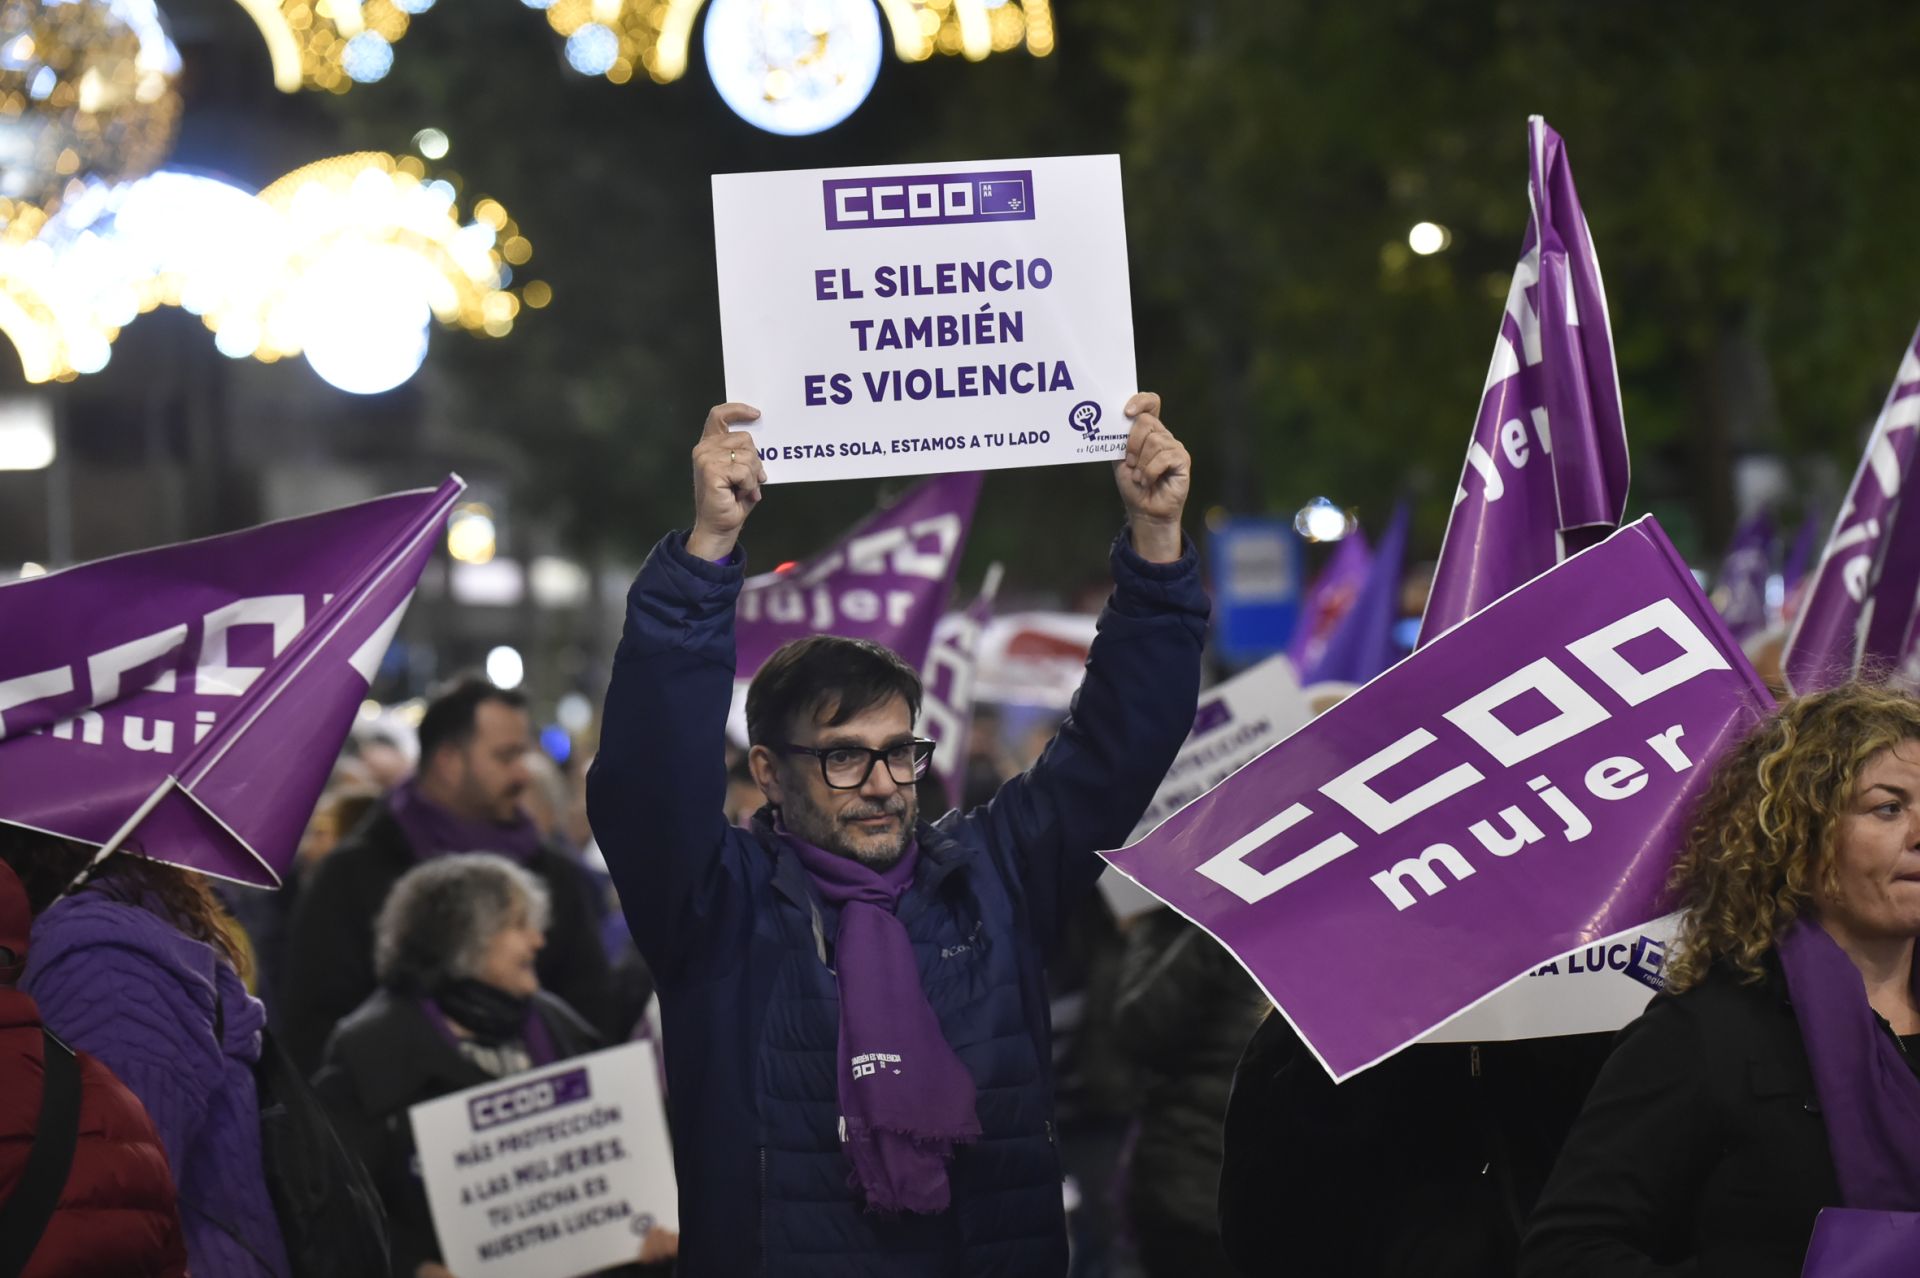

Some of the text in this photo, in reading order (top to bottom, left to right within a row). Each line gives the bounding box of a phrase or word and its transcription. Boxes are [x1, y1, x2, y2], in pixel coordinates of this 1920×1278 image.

[834, 182, 974, 223] CCOO
[815, 257, 1053, 301] EL SILENCIO
[850, 302, 1025, 352] TAMBIÉN
[804, 360, 1075, 407] ES VIOLENCIA
[757, 430, 1051, 461] NO ESTAS SOLA, ESTAMOS A TU LADO
[1085, 441, 1128, 454] IGUALDAD
[1096, 433, 1130, 442] FEMINISM
[740, 580, 915, 630] ujer
[1194, 597, 1732, 905] CCOO
[1369, 723, 1694, 912] mujer
[1642, 972, 1667, 989] regió
[851, 1053, 870, 1066] AMBIÉN
[477, 1176, 511, 1200] LAS
[487, 1175, 609, 1226] TU LUCHA ES
[477, 1200, 632, 1261] NUESTRA LUCHA
